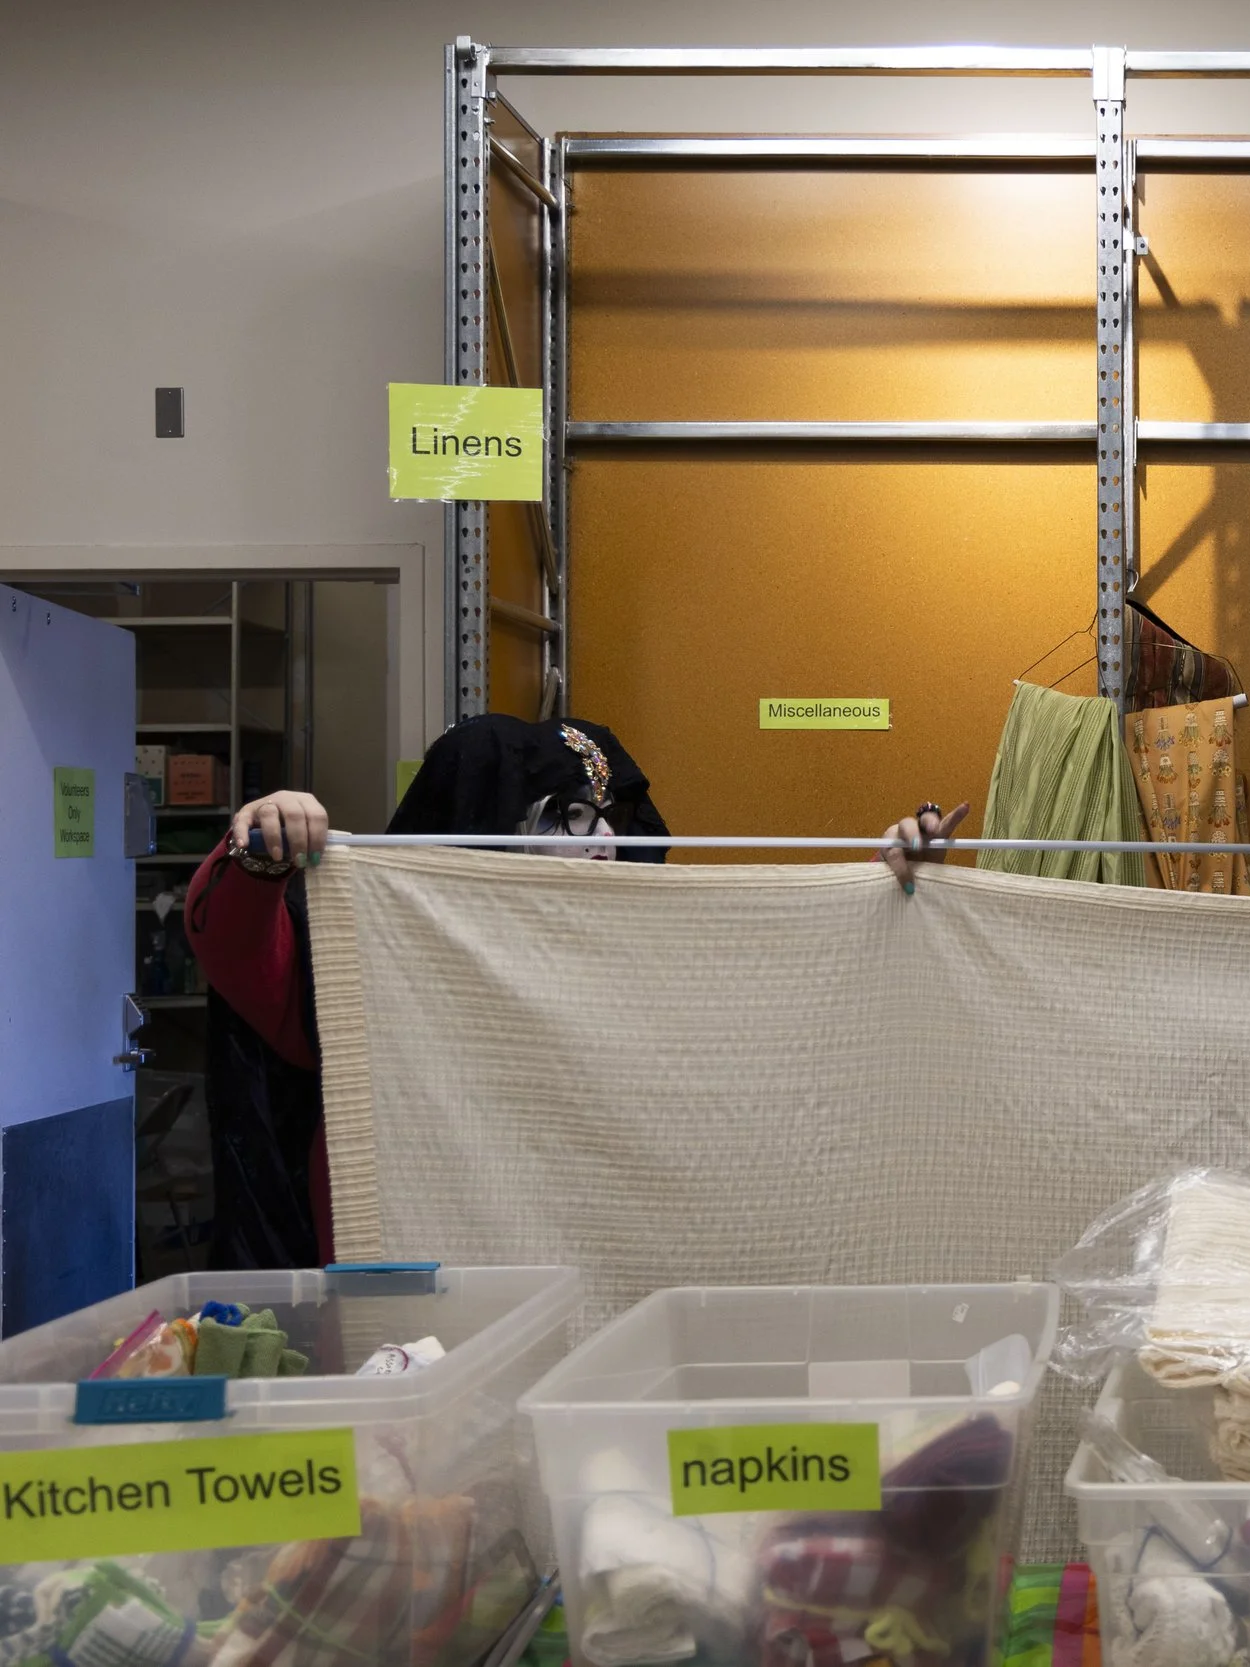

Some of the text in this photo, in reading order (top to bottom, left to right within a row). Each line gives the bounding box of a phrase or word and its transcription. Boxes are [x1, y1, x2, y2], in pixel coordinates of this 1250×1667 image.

[412, 427, 522, 457] Linens
[768, 703, 881, 718] Miscellaneous
[60, 782, 90, 797] Volunteers
[67, 805, 82, 823] Only
[60, 829, 90, 846] Workspace
[682, 1446, 850, 1493] napkins
[3, 1459, 342, 1519] Kitchen Towels
